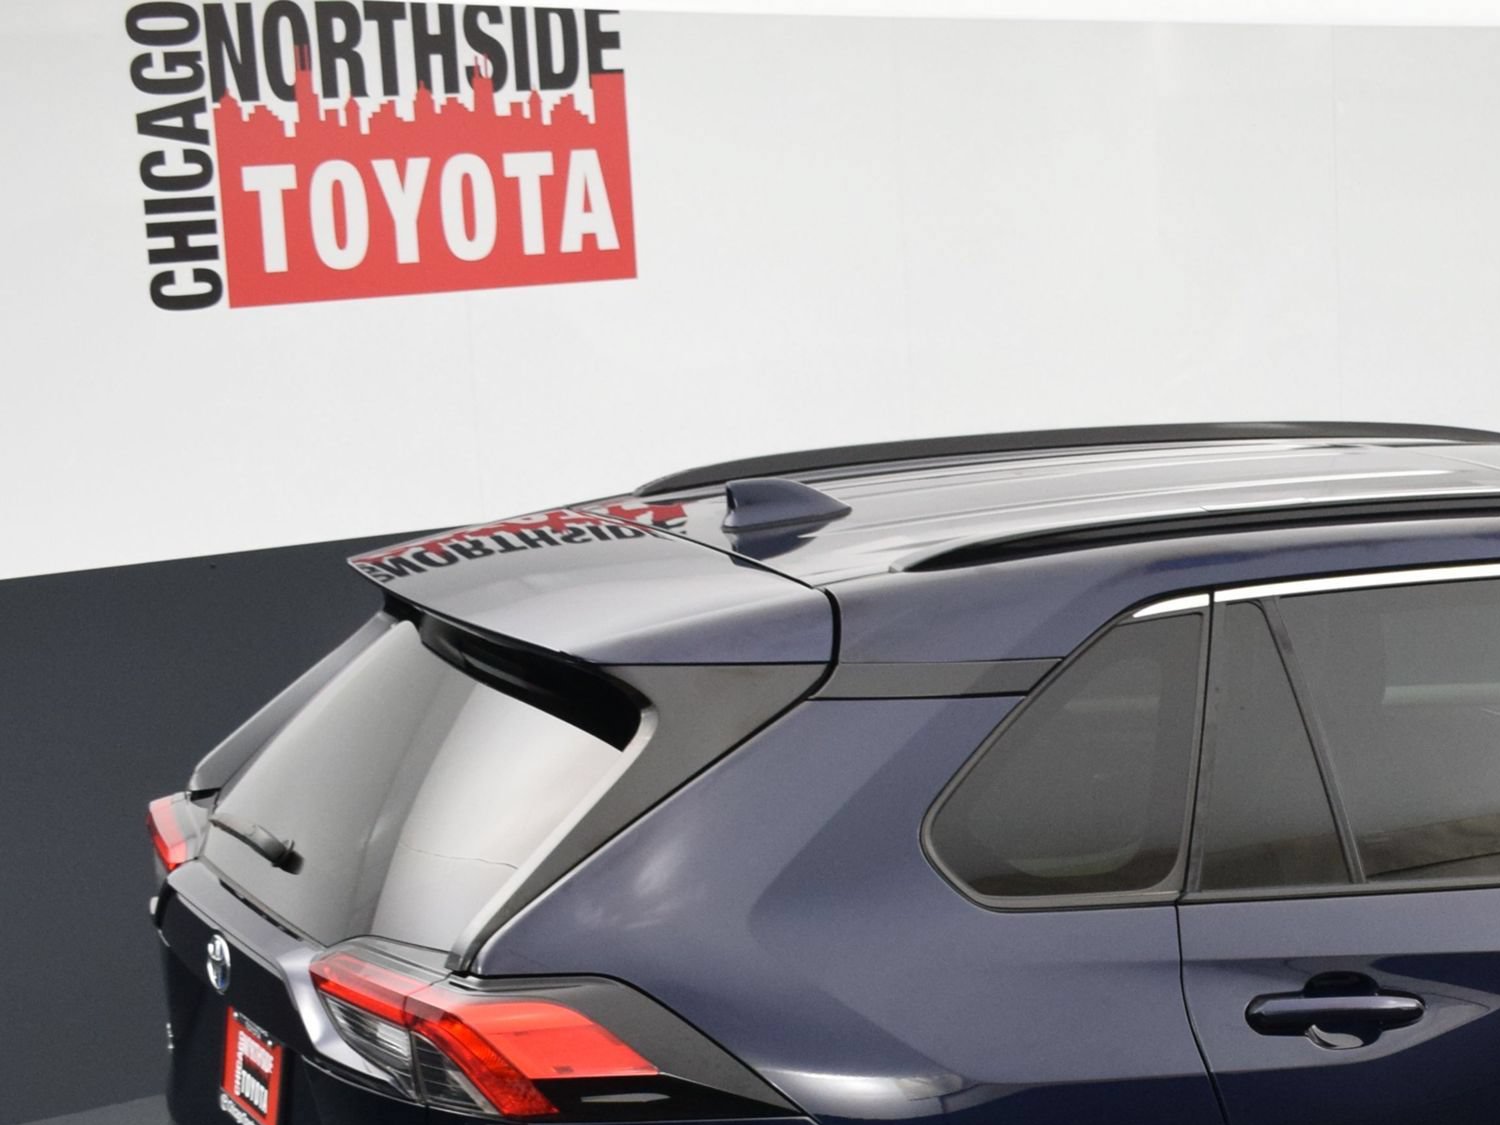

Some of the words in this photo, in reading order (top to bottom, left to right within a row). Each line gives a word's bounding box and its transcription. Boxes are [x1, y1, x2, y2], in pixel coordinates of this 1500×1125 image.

[201, 0, 622, 102] NORTHSIDE
[125, 1, 223, 311] CHICAGO
[241, 149, 620, 273] TOYOTA
